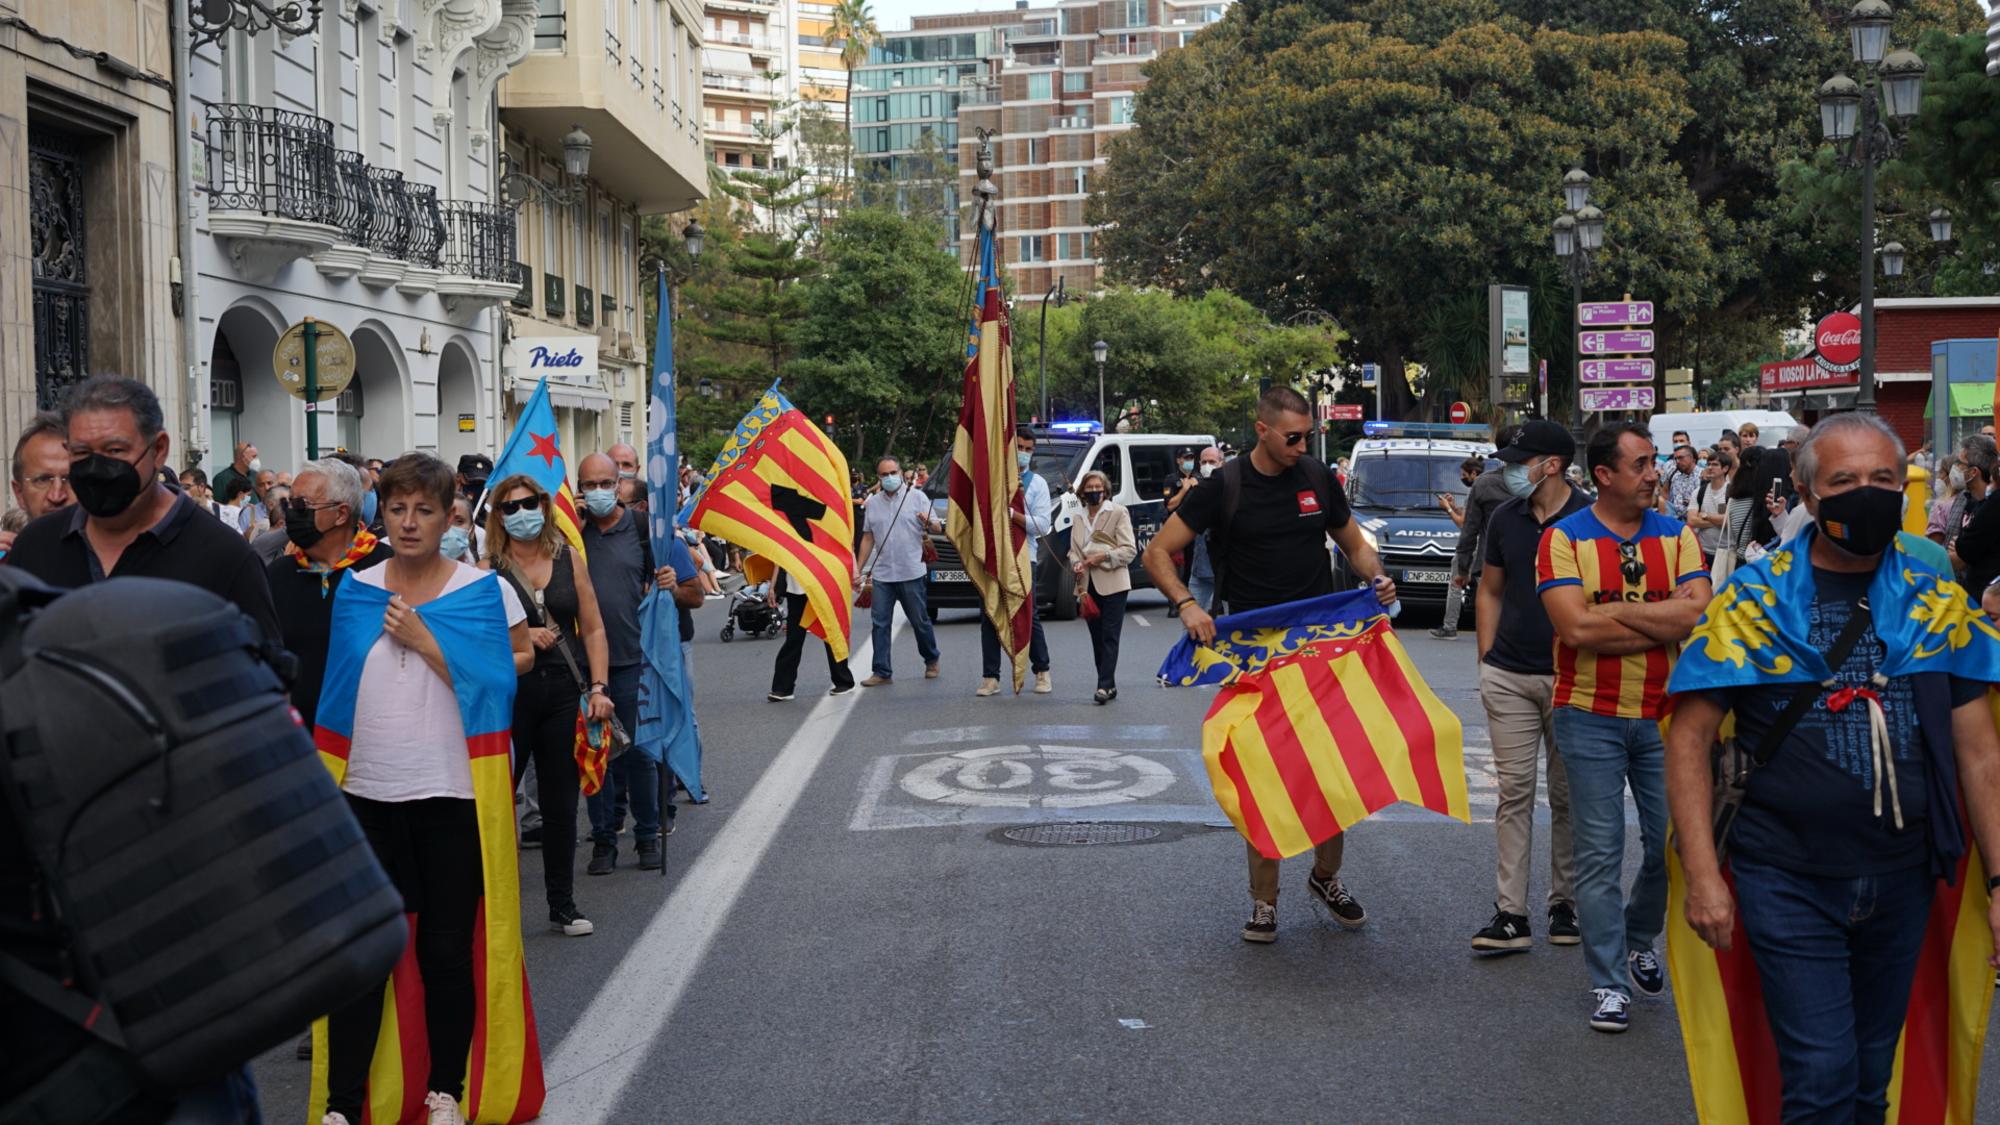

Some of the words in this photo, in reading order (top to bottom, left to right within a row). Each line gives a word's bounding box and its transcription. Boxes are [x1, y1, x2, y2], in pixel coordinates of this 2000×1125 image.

[529, 346, 584, 368] Prieto
[1779, 365, 1805, 384] KIOSCO
[1806, 365, 1815, 381] LA
